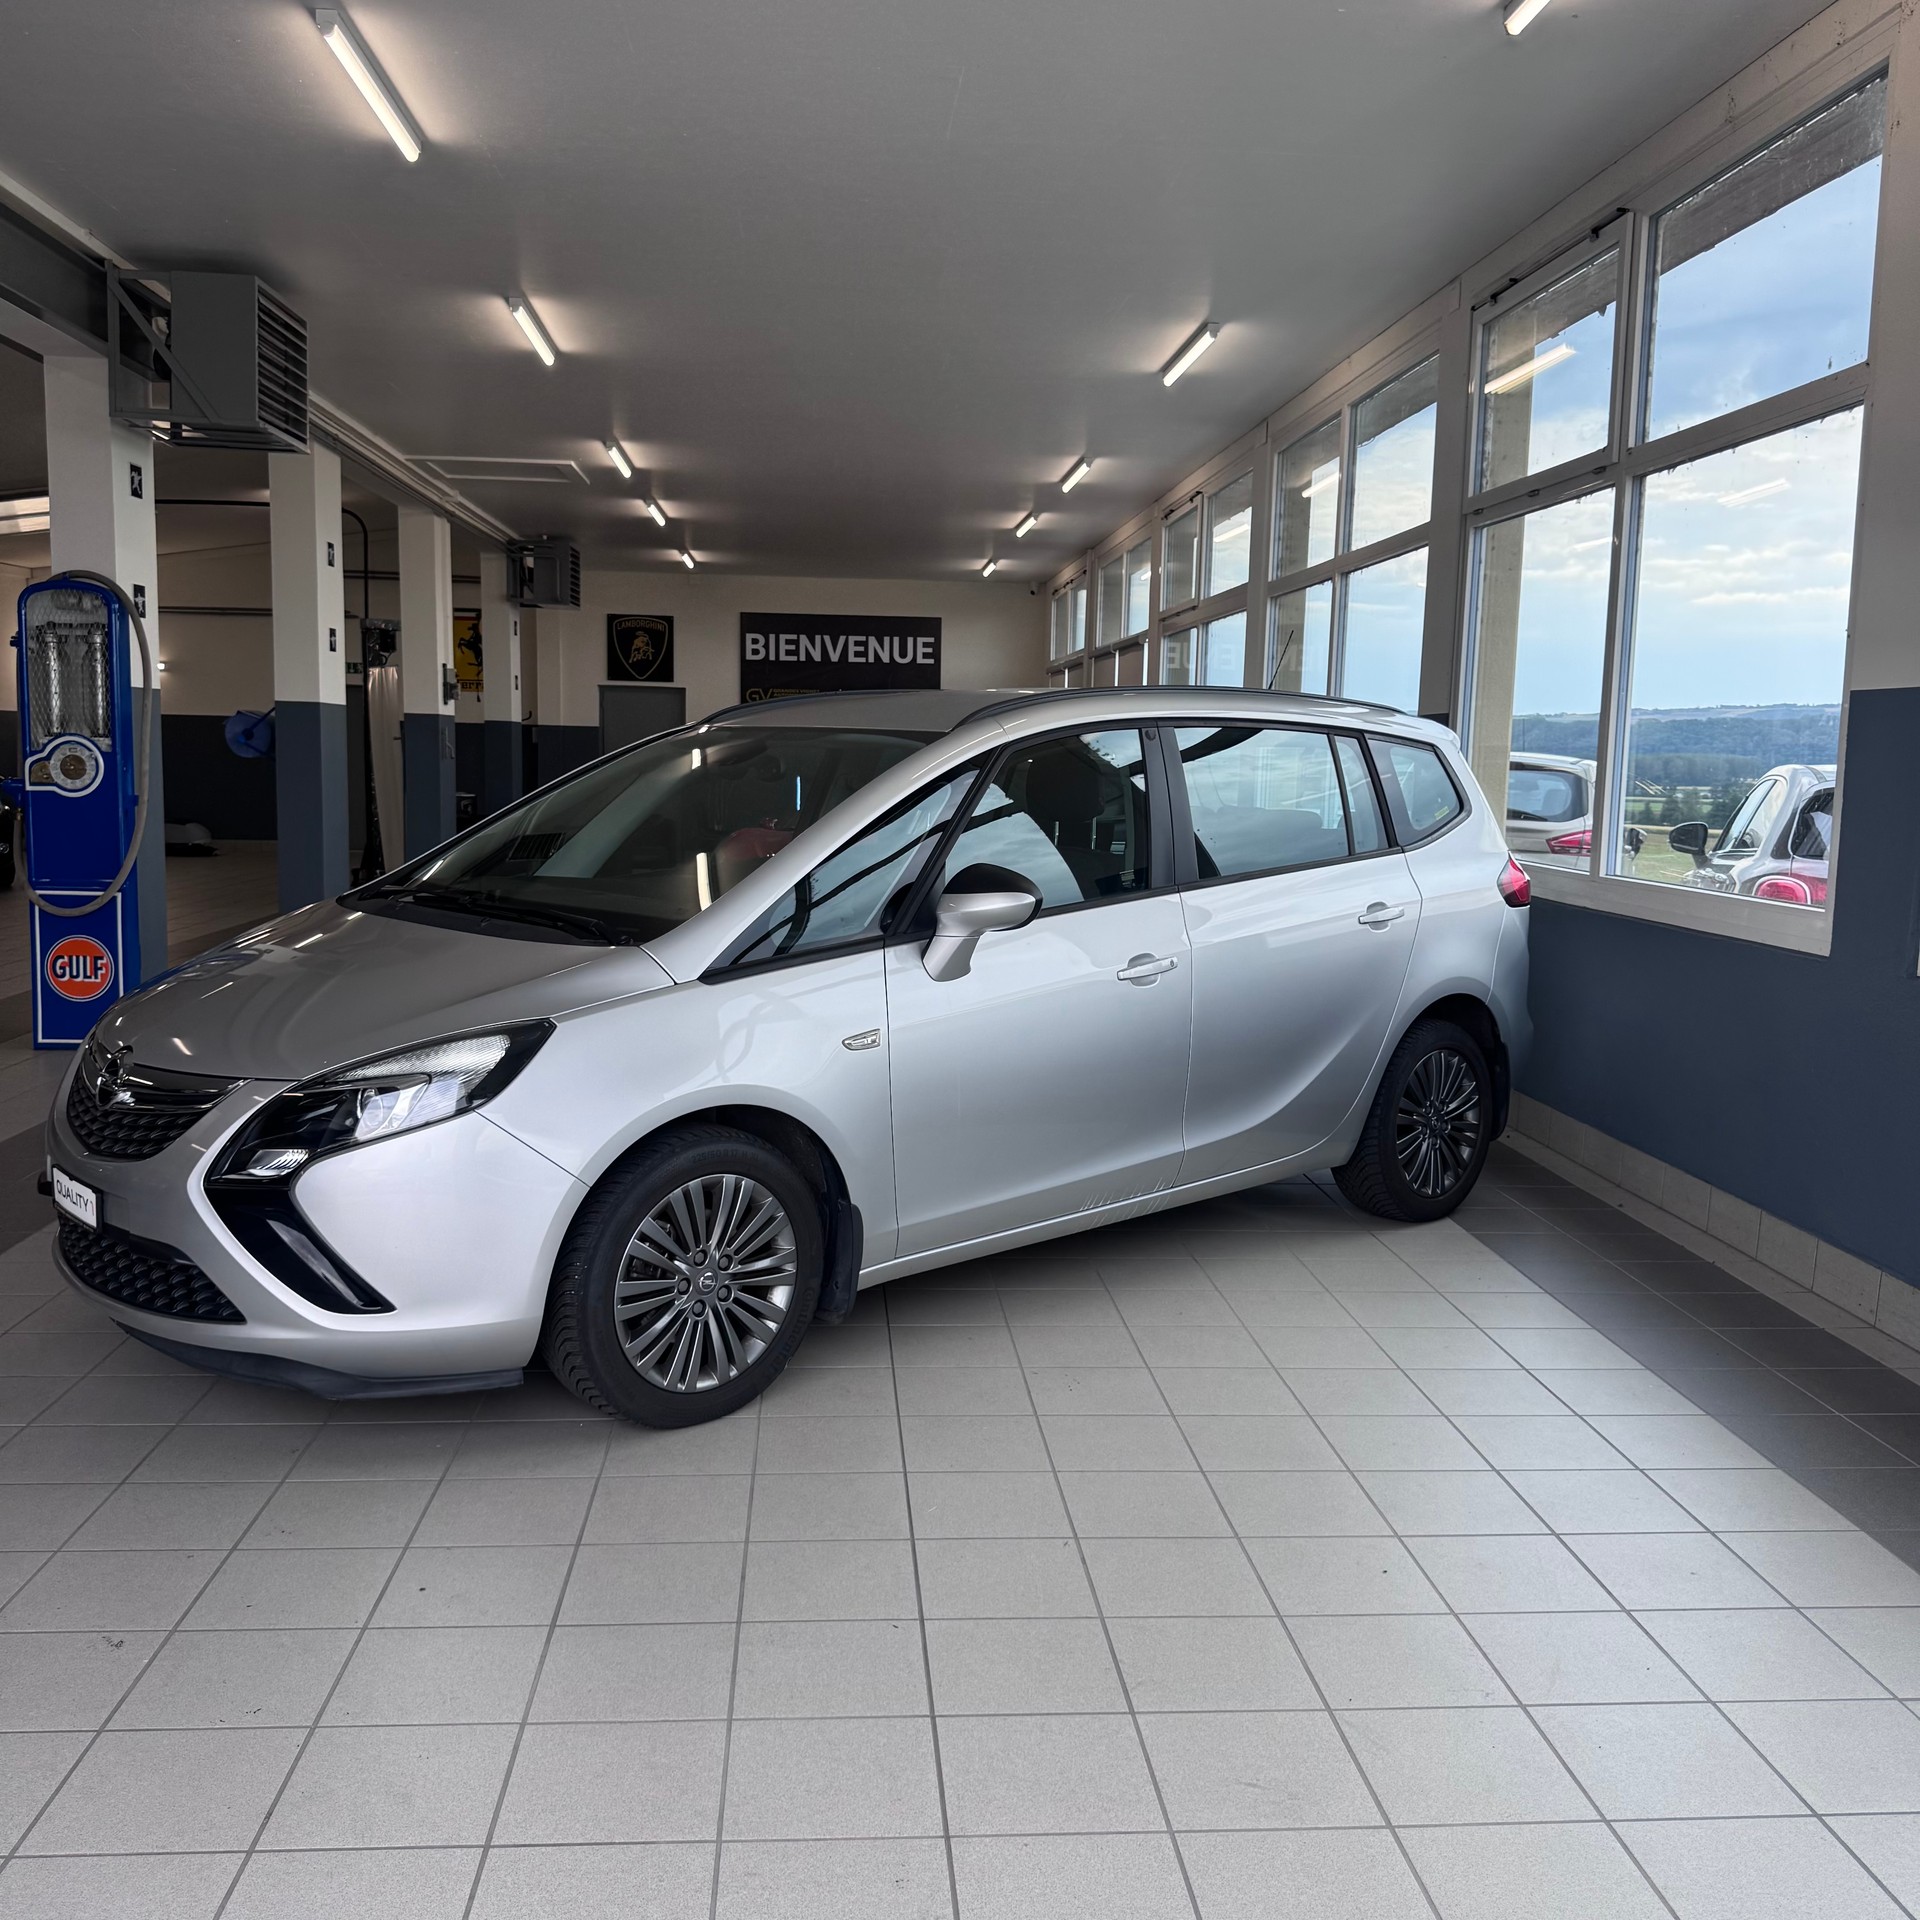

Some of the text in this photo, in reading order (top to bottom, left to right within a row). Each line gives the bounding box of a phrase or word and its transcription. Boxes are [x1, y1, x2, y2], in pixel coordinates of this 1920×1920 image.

[617, 620, 665, 632] LAMBORGHINI
[745, 633, 935, 664] BIENVENUE
[746, 688, 773, 702] GV
[52, 954, 106, 982] GULF
[56, 1179, 89, 1212] QUALITY
